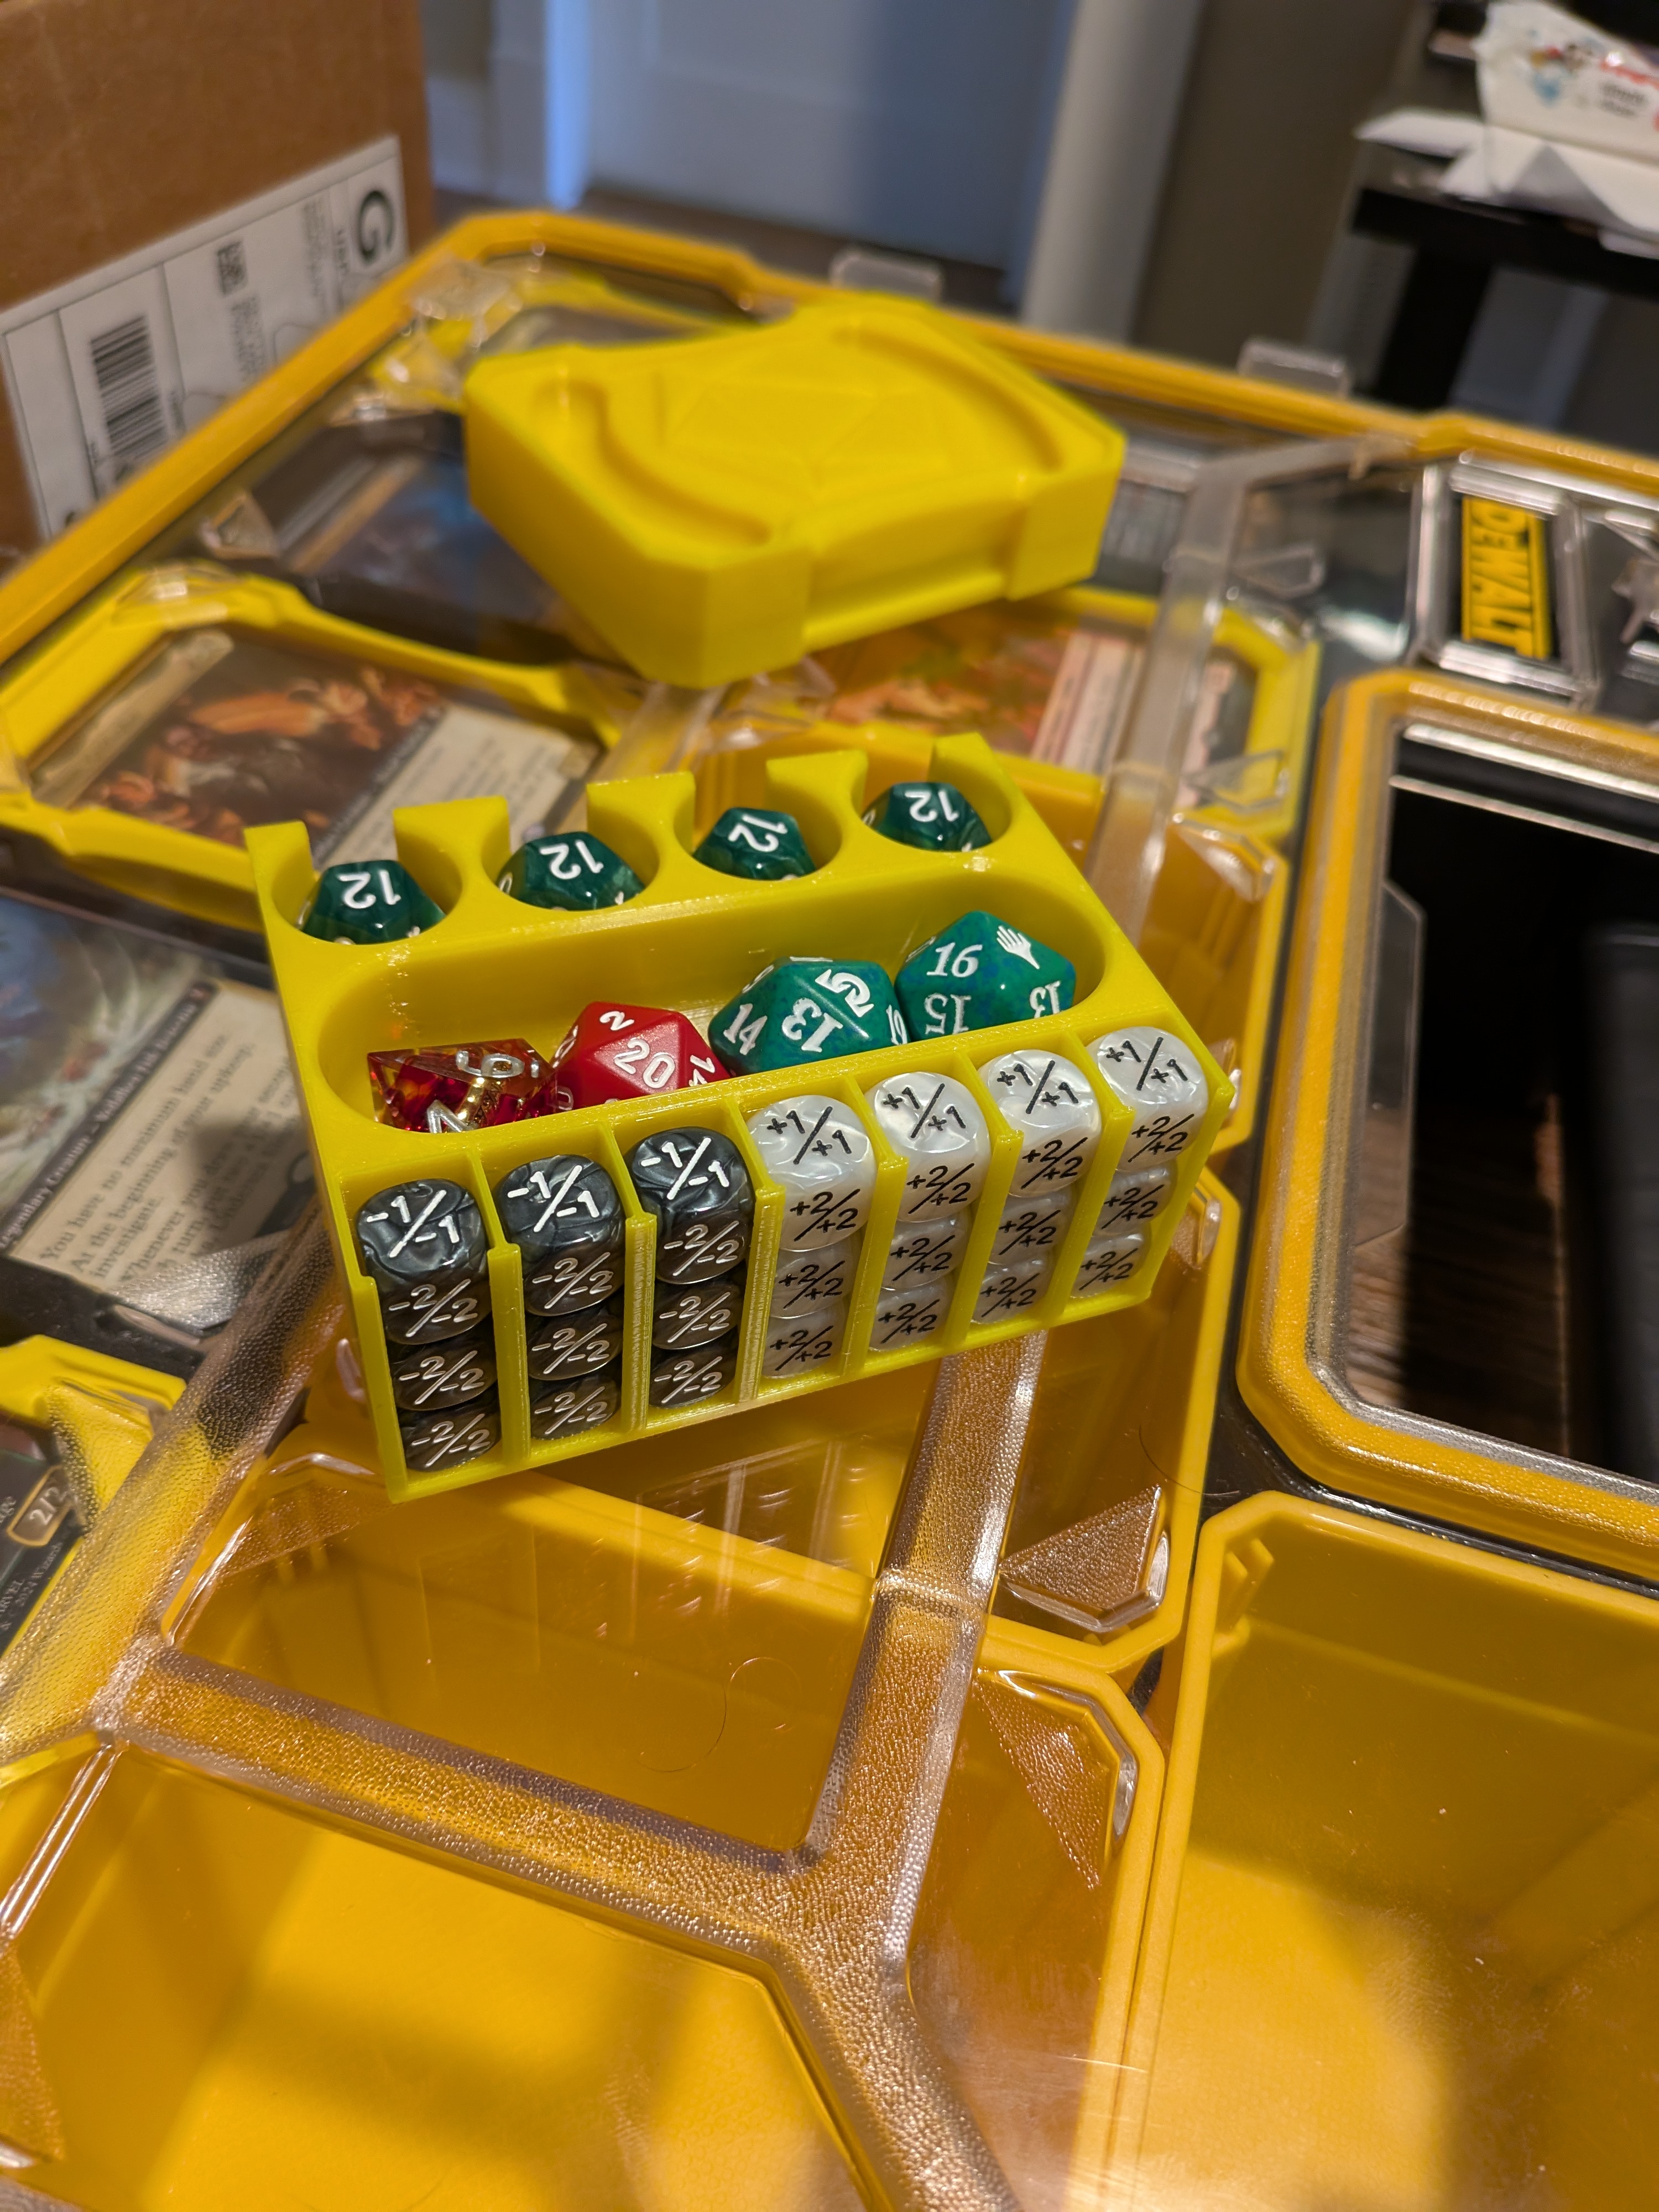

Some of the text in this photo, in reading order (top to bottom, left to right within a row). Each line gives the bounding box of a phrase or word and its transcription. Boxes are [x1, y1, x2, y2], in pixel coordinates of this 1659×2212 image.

[904, 790, 959, 822] 12
[728, 814, 787, 852] 12
[539, 839, 604, 879] 12
[337, 869, 401, 909] 12
[926, 942, 983, 978] 16
[599, 1011, 634, 1031] 2
[723, 1003, 768, 1055] 14
[781, 997, 843, 1052] 13
[925, 993, 972, 1035] 15
[613, 1037, 676, 1089] 20
[998, 1061, 1078, 1114] +1/+1
[1107, 1037, 1187, 1091] +1/+1
[768, 1107, 852, 1164] +1/+1
[884, 1083, 966, 1138] +1/+1
[1128, 1114, 1194, 1162] +2/+2
[641, 1138, 729, 1199] -1/-1
[1023, 1138, 1087, 1189] +2/+2
[508, 1165, 599, 1231] -1/-1
[907, 1164, 974, 1214] +2/+2
[1104, 1186, 1164, 1229] +2/+2
[367, 1191, 460, 1257] -1/-1
[791, 1190, 860, 1241] +2/+2
[1000, 1210, 1061, 1255] +2/+2
[665, 1222, 738, 1275] -2/-2
[891, 1237, 954, 1281] +2/+2
[1080, 1249, 1138, 1291] +2/+2
[533, 1253, 612, 1308] -2/-2
[779, 1261, 844, 1308] +2/+2
[981, 1274, 1039, 1317] +2/+2
[389, 1280, 477, 1337] -2/-2
[660, 1292, 731, 1343] -2/-2
[879, 1300, 940, 1343] +2/+2
[533, 1324, 609, 1374] -2/-2
[771, 1327, 833, 1371] +2/+2
[399, 1352, 484, 1404] -2/-2
[654, 1357, 722, 1402] -2/-2
[535, 1386, 607, 1434] -2/-2
[412, 1414, 490, 1466] -2/-2
